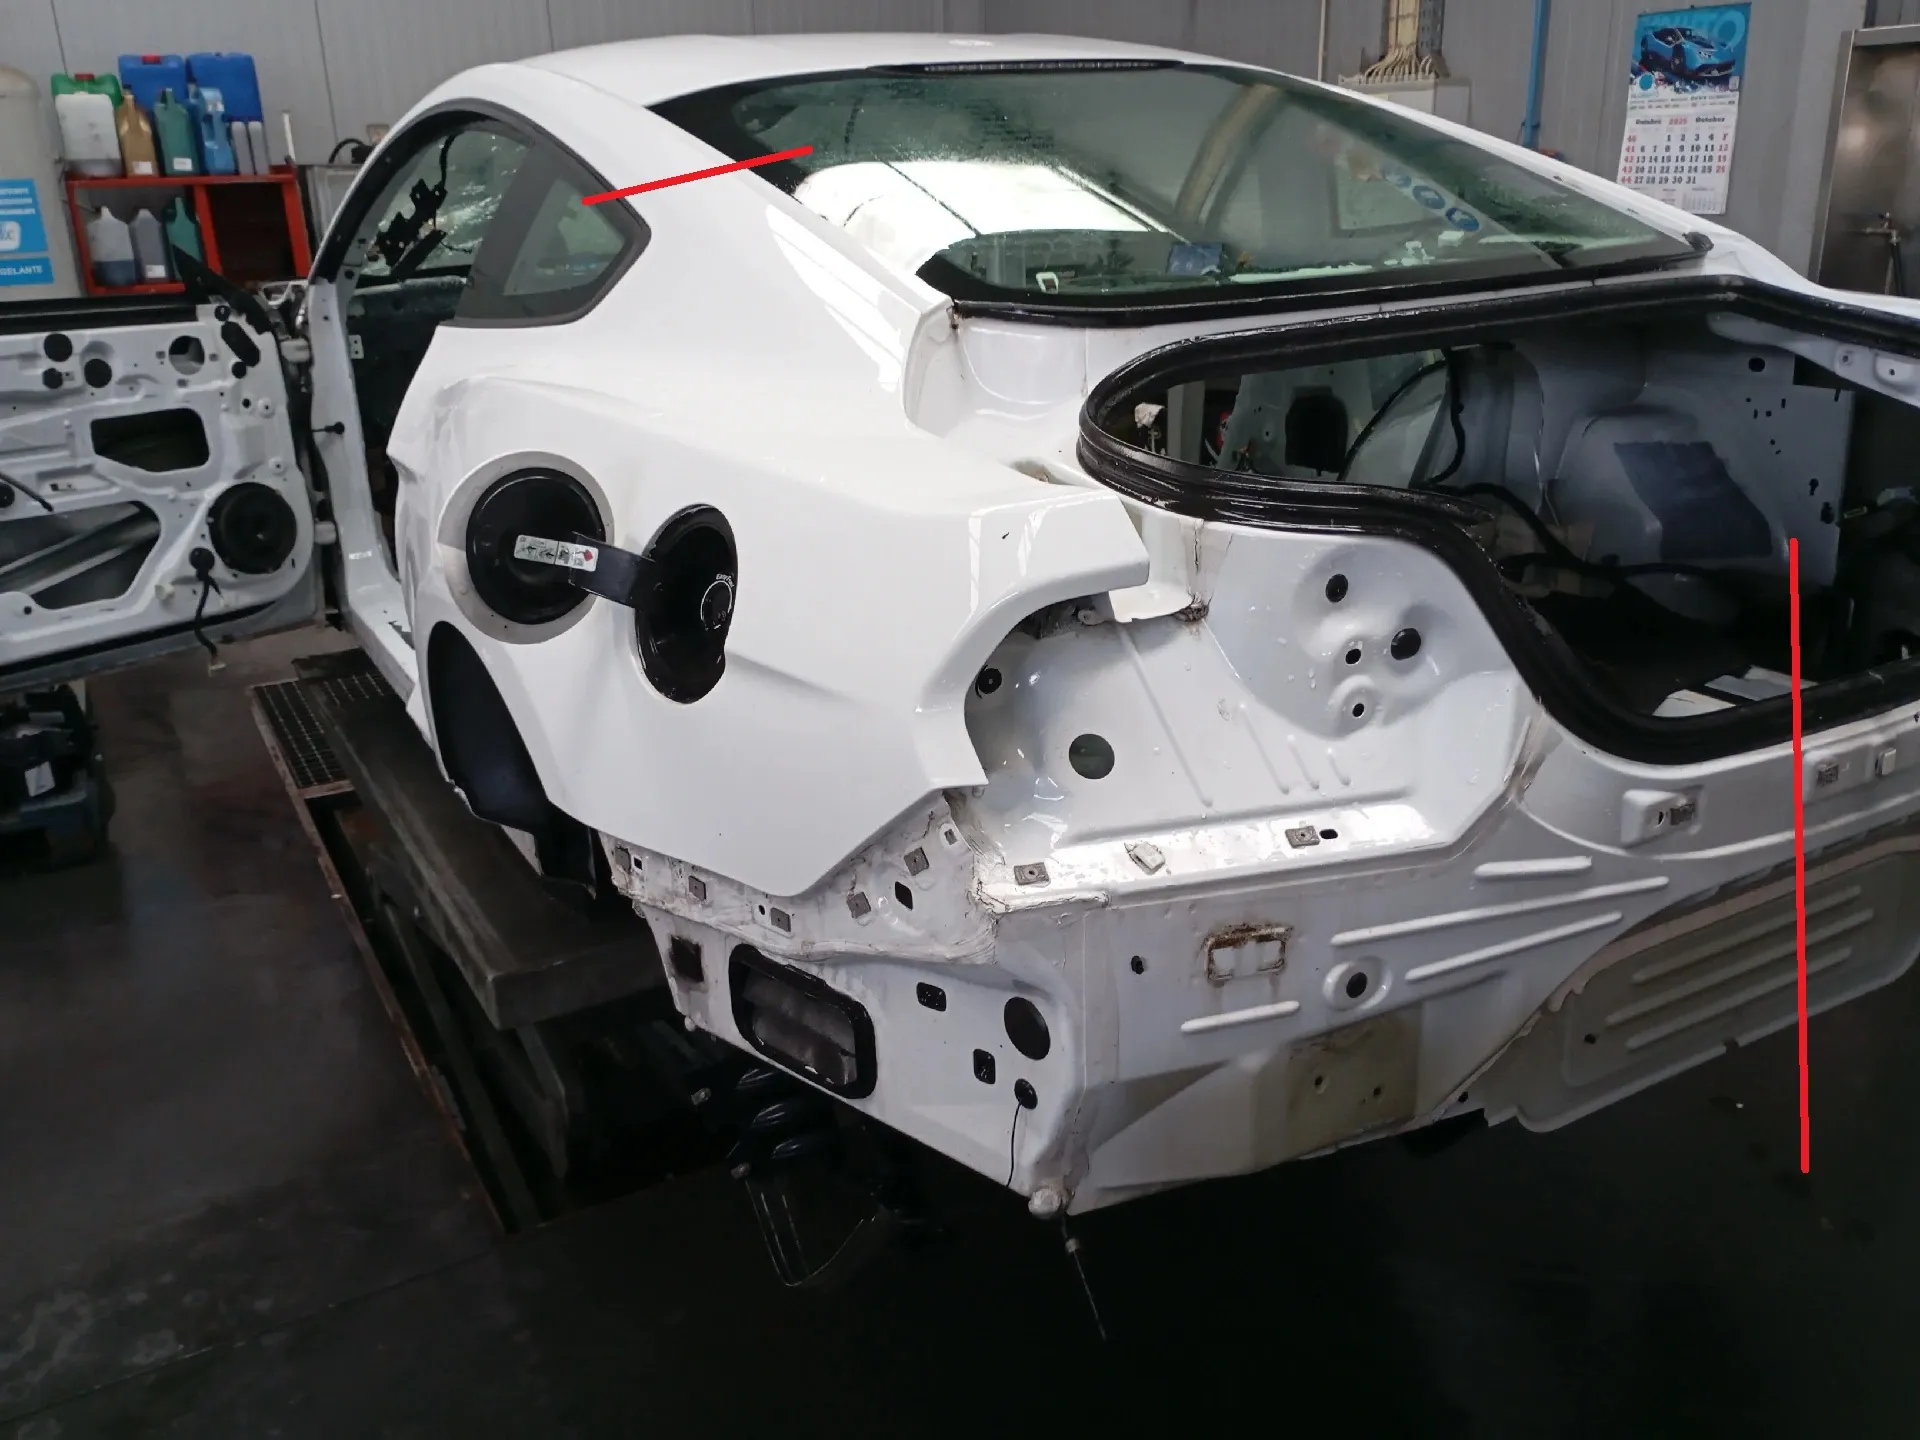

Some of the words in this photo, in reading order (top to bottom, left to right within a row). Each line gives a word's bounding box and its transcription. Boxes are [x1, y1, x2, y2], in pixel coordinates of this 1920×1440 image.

[1681, 133, 1686, 141] 2
[1694, 133, 1700, 141] 3
[1708, 133, 1714, 141] 4
[1691, 144, 1701, 152] 10
[1704, 144, 1714, 152] 11
[1635, 166, 1645, 174] 20
[1660, 166, 1670, 174] 22
[1634, 176, 1644, 184] 27
[1646, 176, 1656, 184] 28
[1658, 176, 1669, 184] 29
[1672, 176, 1683, 184] 30
[1685, 176, 1696, 184] 31
